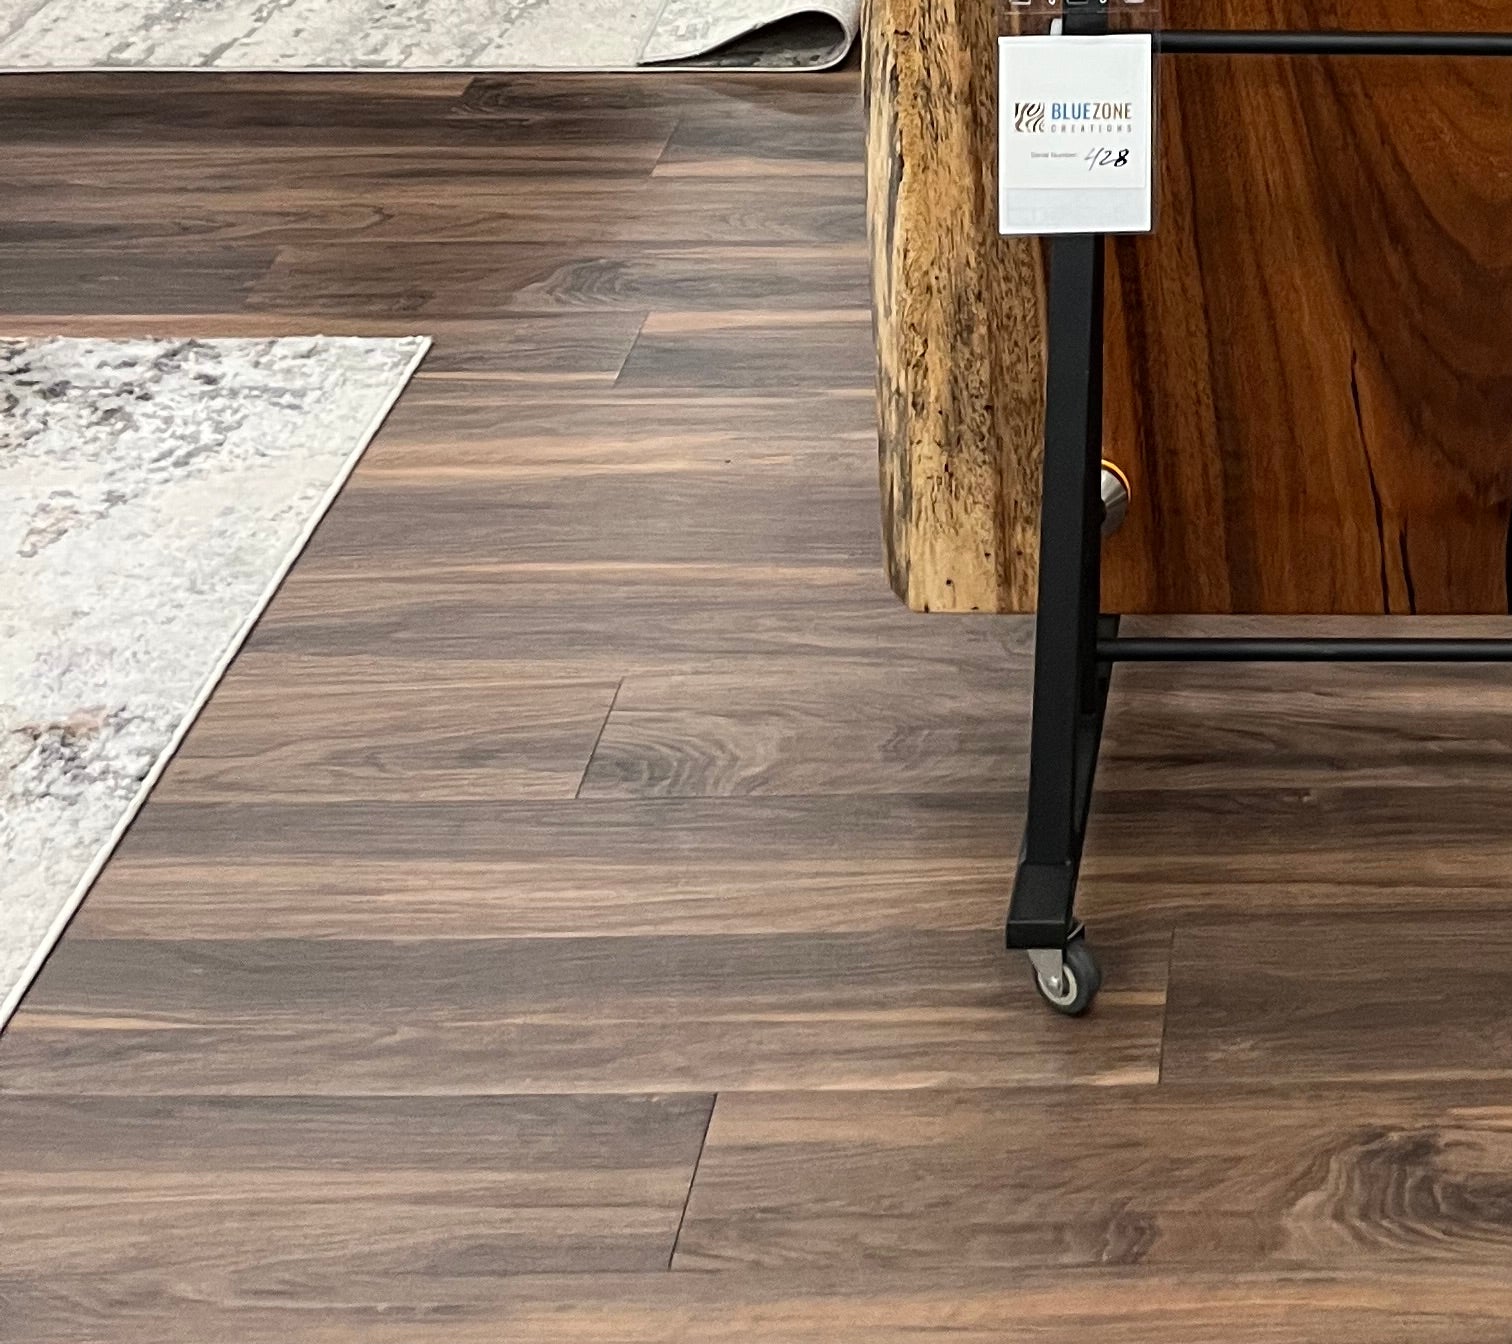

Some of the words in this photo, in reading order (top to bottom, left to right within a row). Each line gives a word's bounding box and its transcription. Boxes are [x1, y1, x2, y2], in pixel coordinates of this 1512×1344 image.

[1051, 102, 1132, 120] BLUEZONE
[1050, 123, 1132, 133] CREATIONS
[1084, 147, 1130, 172] 428
